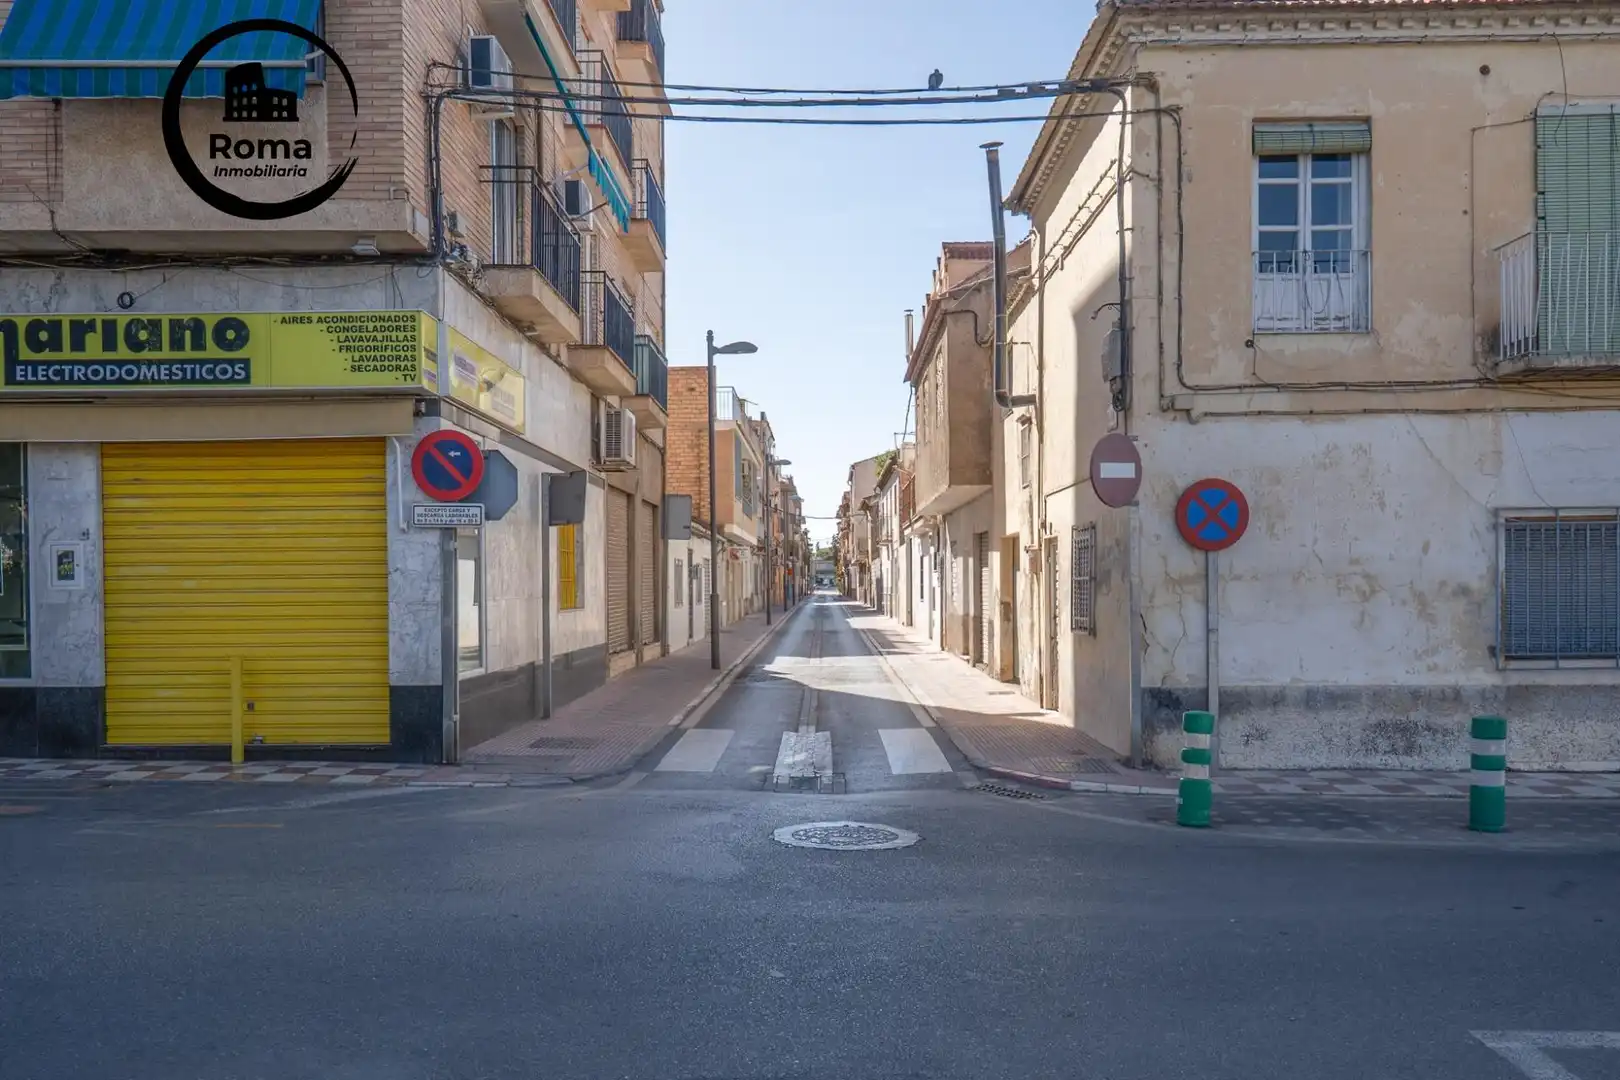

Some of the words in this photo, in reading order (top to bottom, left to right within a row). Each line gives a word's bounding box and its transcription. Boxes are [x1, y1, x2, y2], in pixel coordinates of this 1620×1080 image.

[280, 315, 313, 325] AIRES
[316, 315, 417, 324] ACONDICIONADOS
[326, 324, 417, 334] CONGELADORES
[337, 334, 417, 344] LAVAVAJILLAS
[338, 343, 417, 353] FRIGORÍFICOS
[351, 354, 417, 363] LAVADORAS
[15, 363, 246, 381] ELECTRODOMESTICOS
[350, 363, 417, 373] SECADORAS
[402, 373, 417, 382] TV
